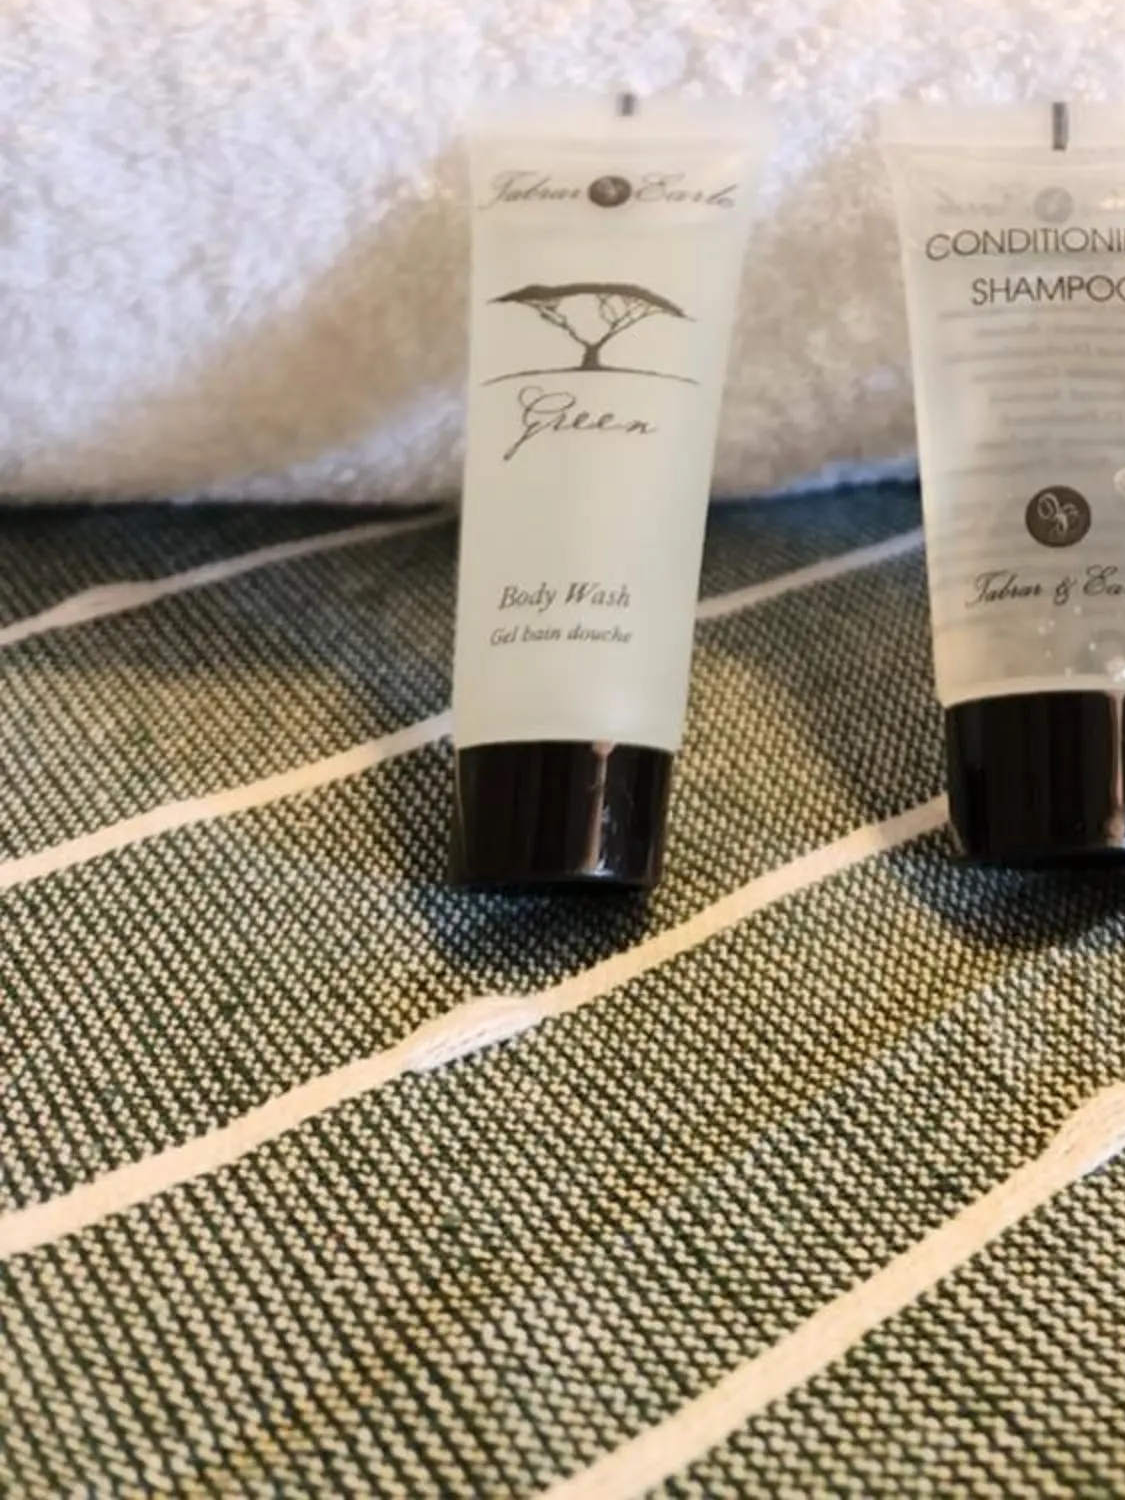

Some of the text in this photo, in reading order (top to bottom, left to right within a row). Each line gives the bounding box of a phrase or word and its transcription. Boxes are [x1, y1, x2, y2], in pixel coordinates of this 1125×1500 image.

[503, 386, 658, 461] Green
[497, 581, 631, 614] Body Wash
[1052, 576, 1077, 607] &
[490, 621, 633, 646] Gel bain douche
